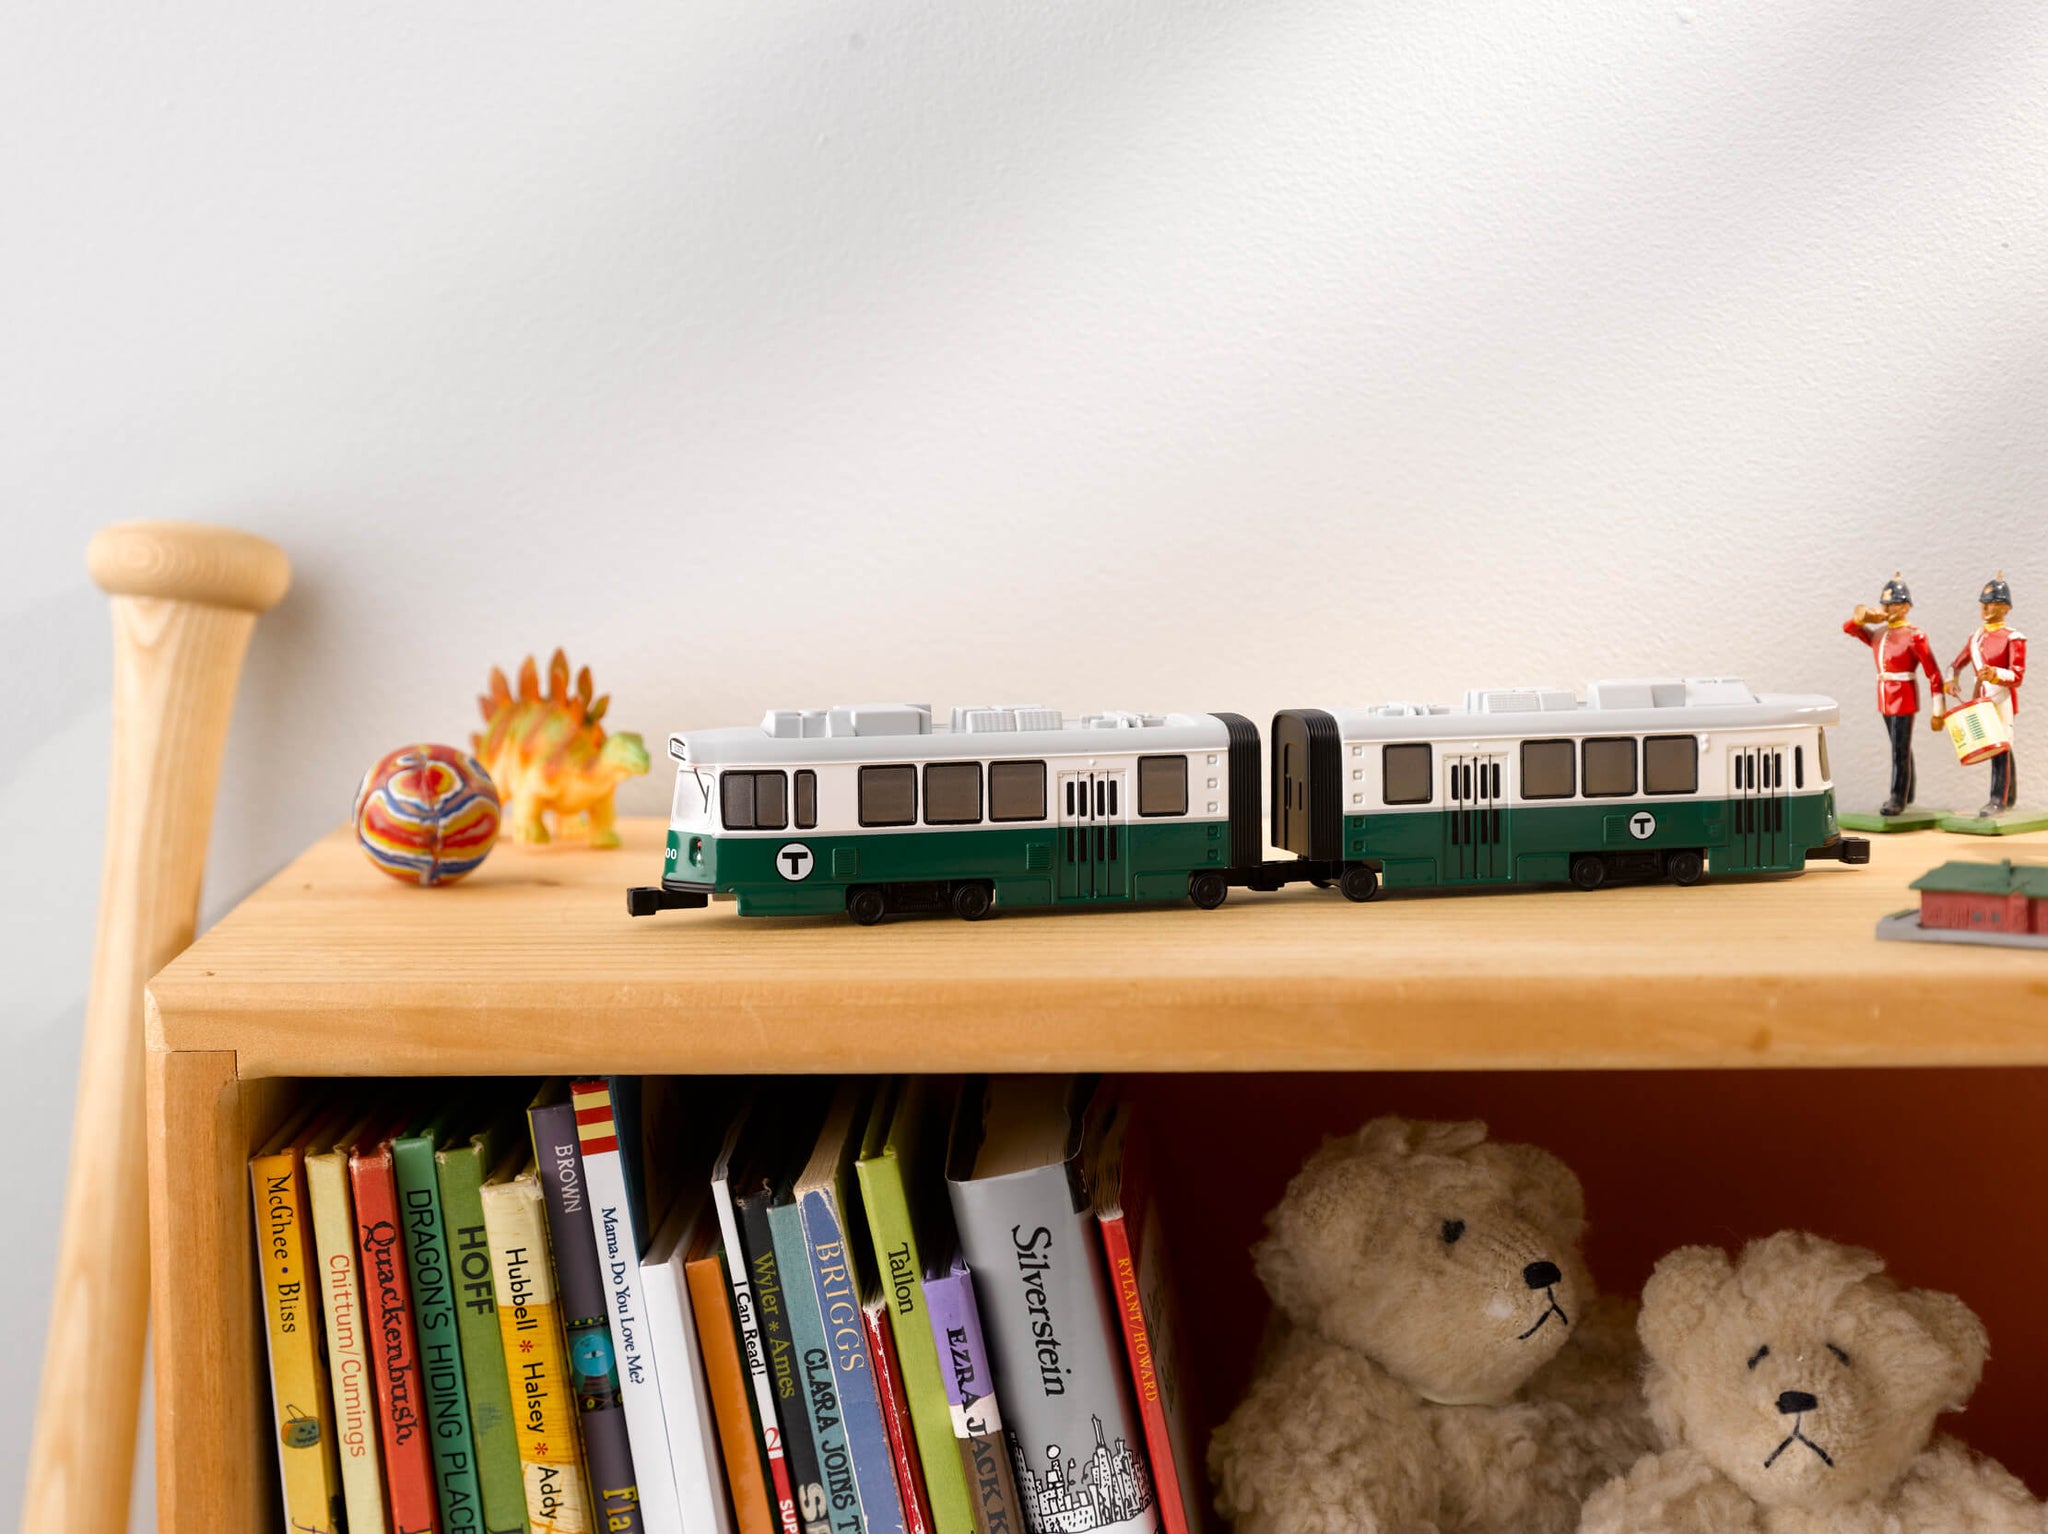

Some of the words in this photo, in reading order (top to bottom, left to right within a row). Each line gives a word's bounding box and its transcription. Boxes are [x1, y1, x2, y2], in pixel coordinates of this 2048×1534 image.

[782, 852, 808, 875] T
[267, 1171, 294, 1260] McGhee
[554, 1143, 582, 1214] BROWN
[406, 1189, 452, 1330] DRAGON'S
[457, 1225, 494, 1315] HOFF
[602, 1207, 618, 1259] Mama,
[611, 1261, 626, 1285] Do
[278, 1280, 301, 1333] Bliss
[615, 1286, 631, 1314] You
[815, 1240, 865, 1371] BRIGGS
[888, 1242, 915, 1315] Tallon
[1011, 1224, 1072, 1397] Silverstein
[329, 1254, 366, 1457] Chittum/Cumings
[362, 1220, 419, 1445] Quackenbush
[620, 1318, 635, 1351] Love
[736, 1292, 750, 1323] Can
[744, 1329, 766, 1376] Read!
[752, 1250, 780, 1314] Wyler
[769, 1337, 795, 1399] Ames
[1118, 1257, 1158, 1402] RYLANT/HOWARD
[428, 1344, 463, 1438] HIDING
[505, 1247, 538, 1330] Hubbell
[522, 1362, 548, 1433] Halsey
[538, 1466, 564, 1519] Addy
[627, 1354, 645, 1384] Me?
[804, 1348, 839, 1434] CLARA
[764, 1427, 782, 1452] 2
[946, 1326, 981, 1413] EZRA
[966, 1418, 1004, 1507] JACK
[441, 1452, 476, 1534] PLACE
[603, 1486, 638, 1534] Fla
[798, 1482, 833, 1534] S
[822, 1440, 856, 1510] JOINS
[837, 1515, 863, 1534] T
